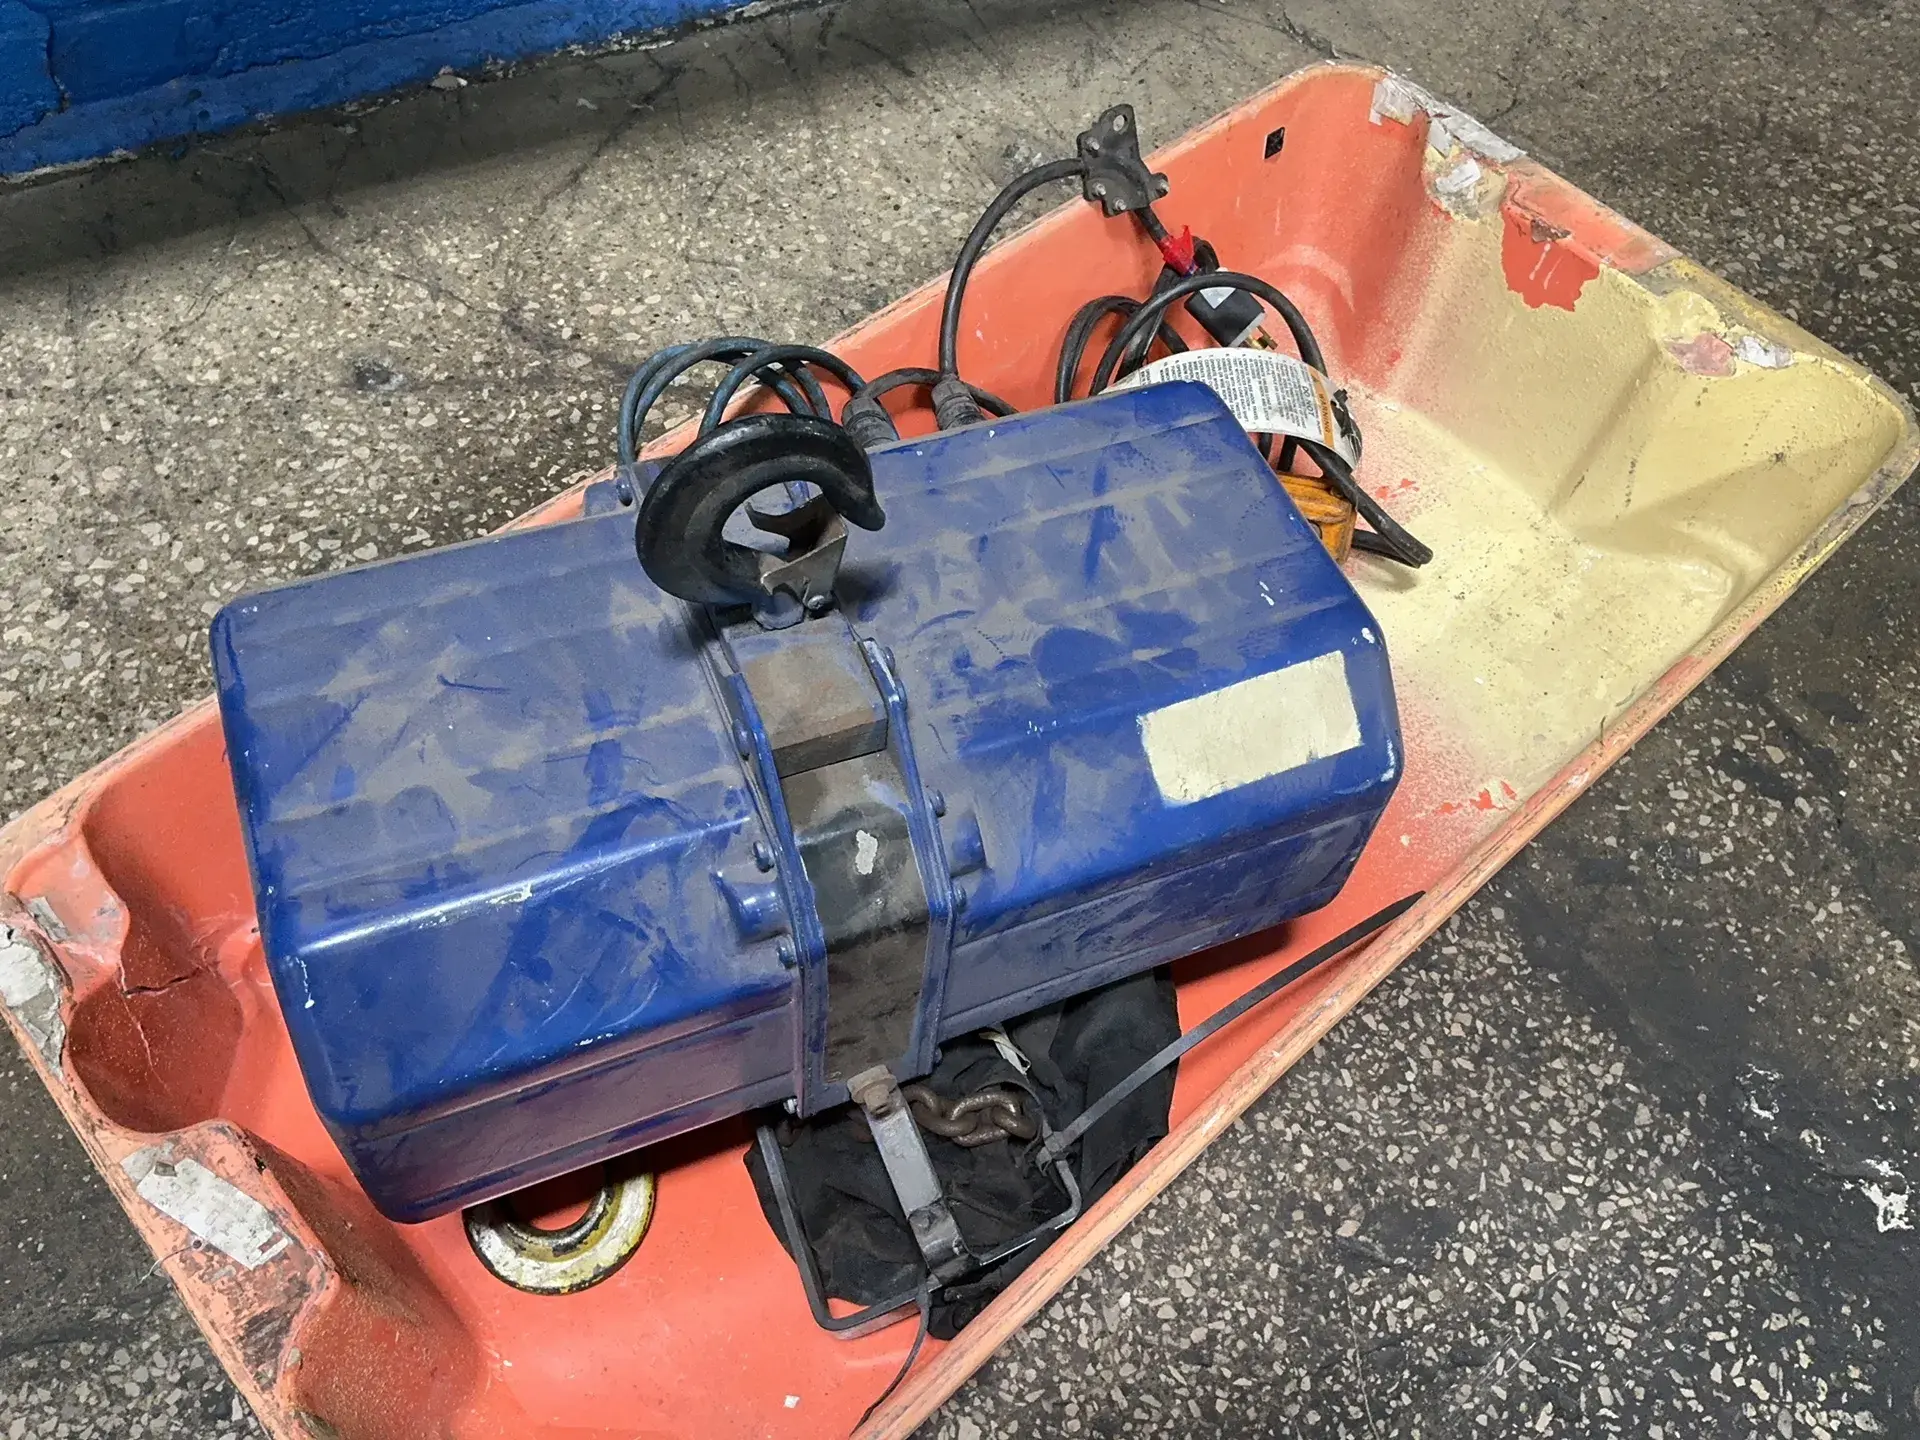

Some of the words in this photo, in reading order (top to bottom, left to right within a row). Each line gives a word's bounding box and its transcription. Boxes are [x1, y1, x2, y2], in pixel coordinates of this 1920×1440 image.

[1302, 386, 1310, 397] DO
[1306, 401, 1314, 416] NOT
[1320, 394, 1330, 432] WARNING
